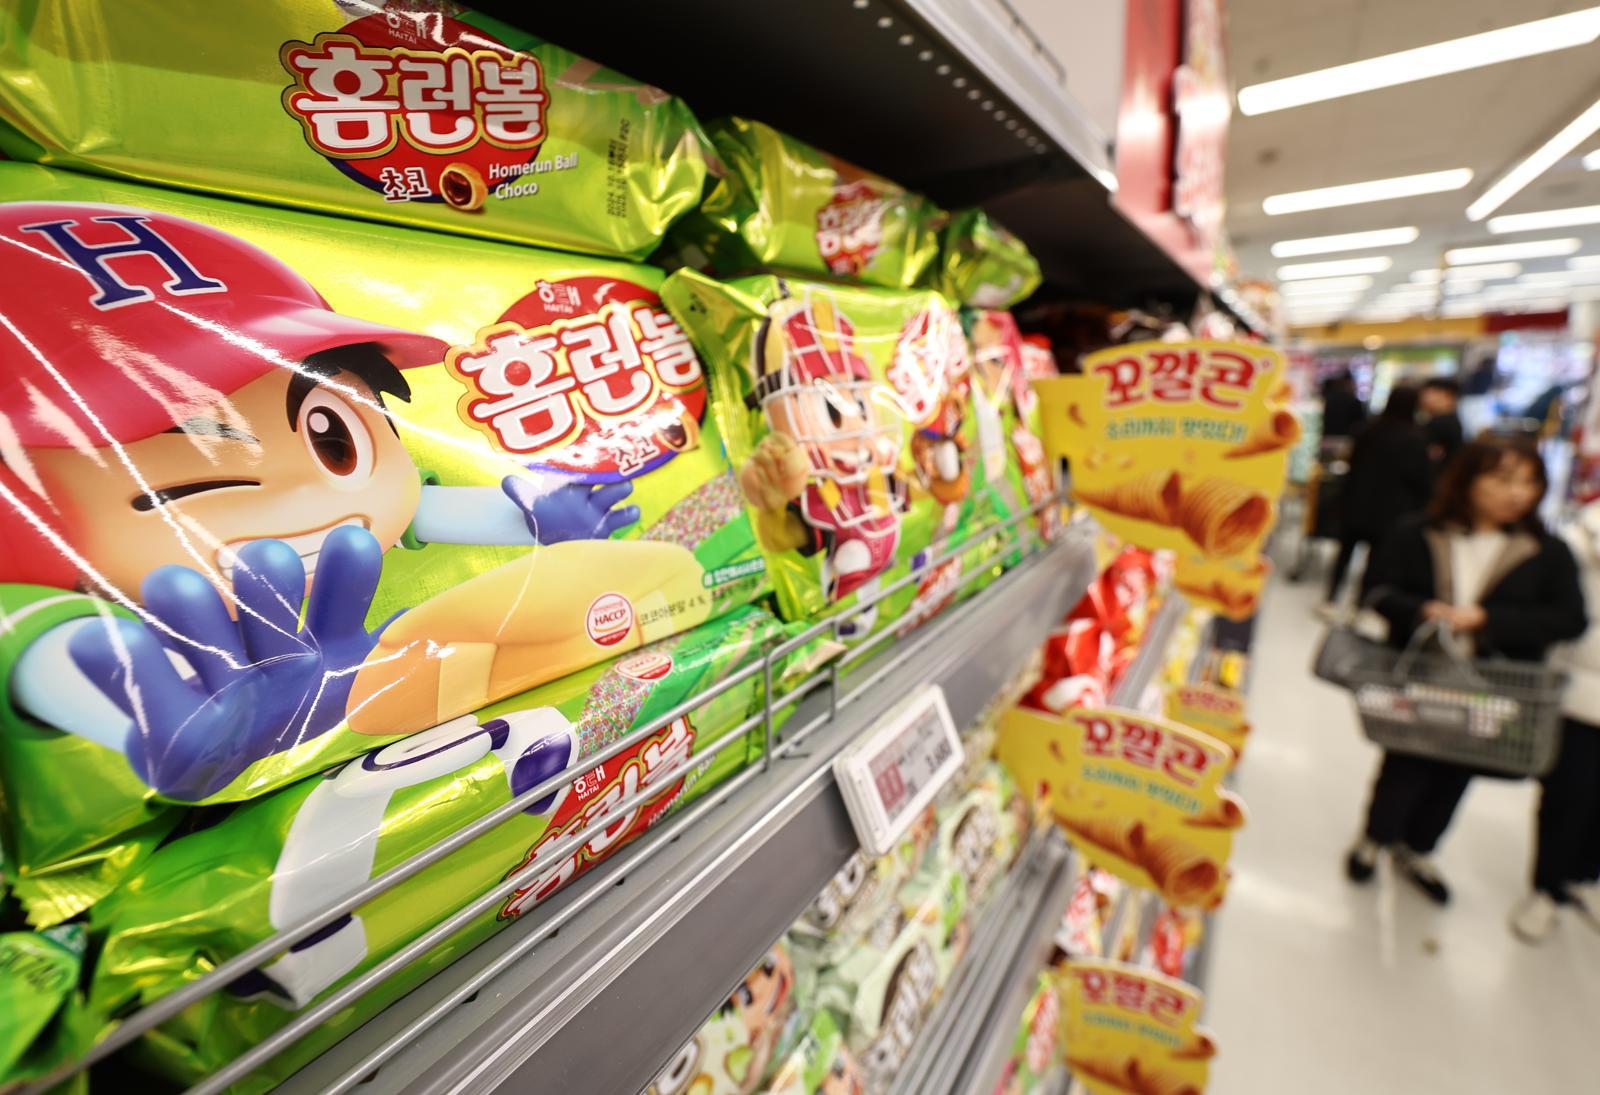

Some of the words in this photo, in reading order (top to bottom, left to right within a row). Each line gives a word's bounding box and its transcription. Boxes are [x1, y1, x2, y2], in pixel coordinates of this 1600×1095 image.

[294, 47, 545, 149] 홈런볼
[380, 167, 432, 203] 초코
[489, 159, 552, 179] Homerun
[555, 152, 578, 169] Ball
[495, 182, 538, 200] Choco
[20, 215, 226, 311] H
[460, 308, 702, 451] 홈런볼
[1094, 350, 1256, 409] 꼬깔콘
[594, 608, 627, 627] HACCP
[1073, 715, 1209, 787] 꼬깔콘
[577, 784, 600, 801] HAITAI
